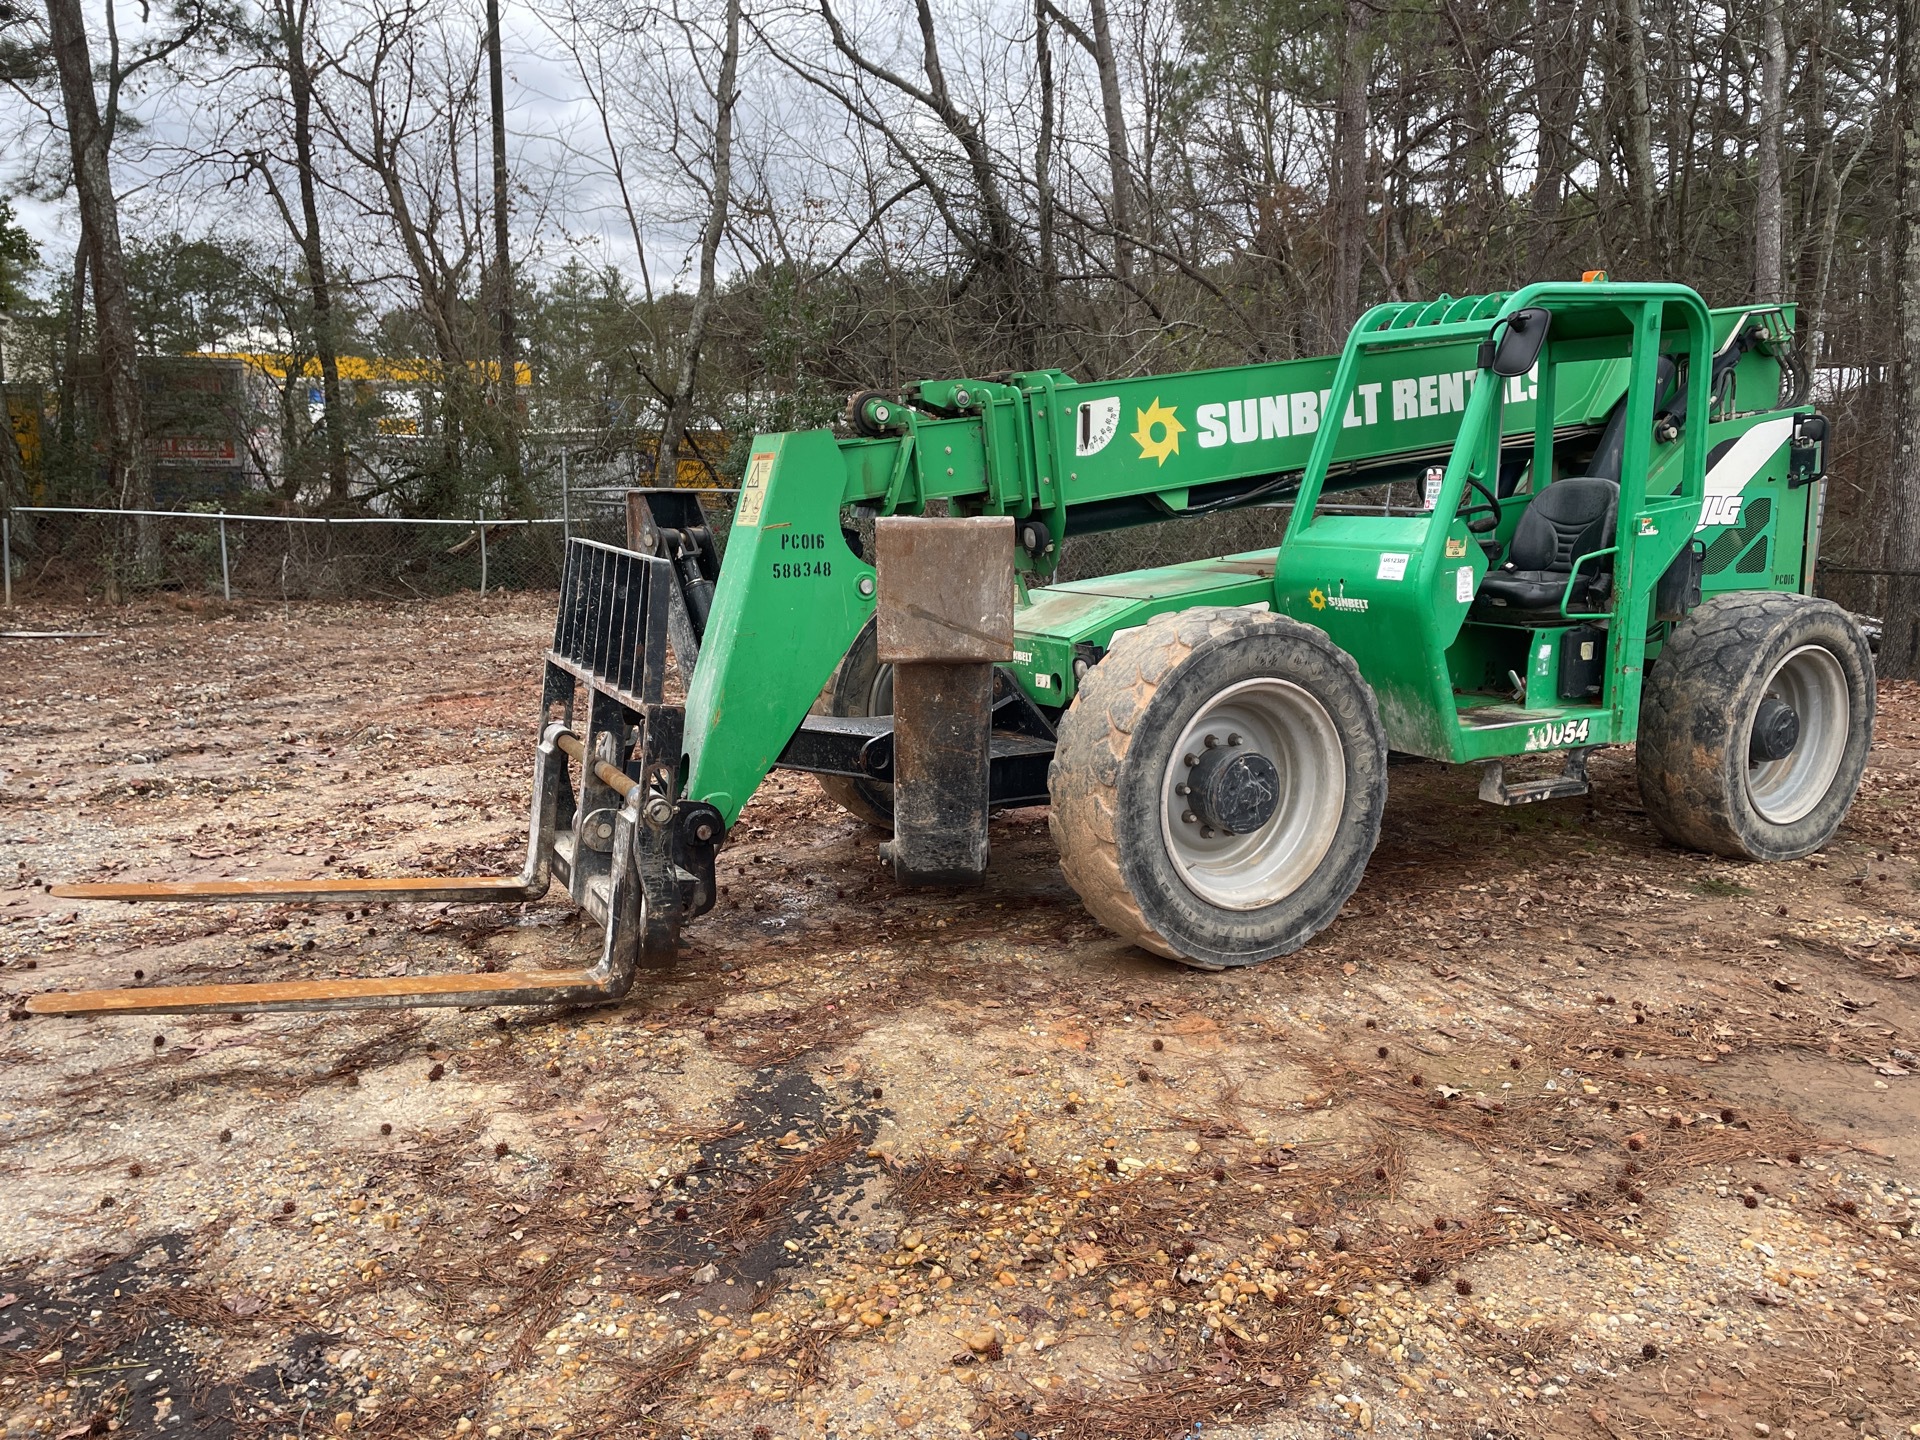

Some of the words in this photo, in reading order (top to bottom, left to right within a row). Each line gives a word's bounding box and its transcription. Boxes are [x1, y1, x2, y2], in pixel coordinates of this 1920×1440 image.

[1697, 495, 1744, 526] JLG
[781, 533, 825, 550] PC016
[772, 561, 832, 579] 588348
[1774, 573, 1795, 586] PC016
[1327, 596, 1369, 609] SUNBELT
